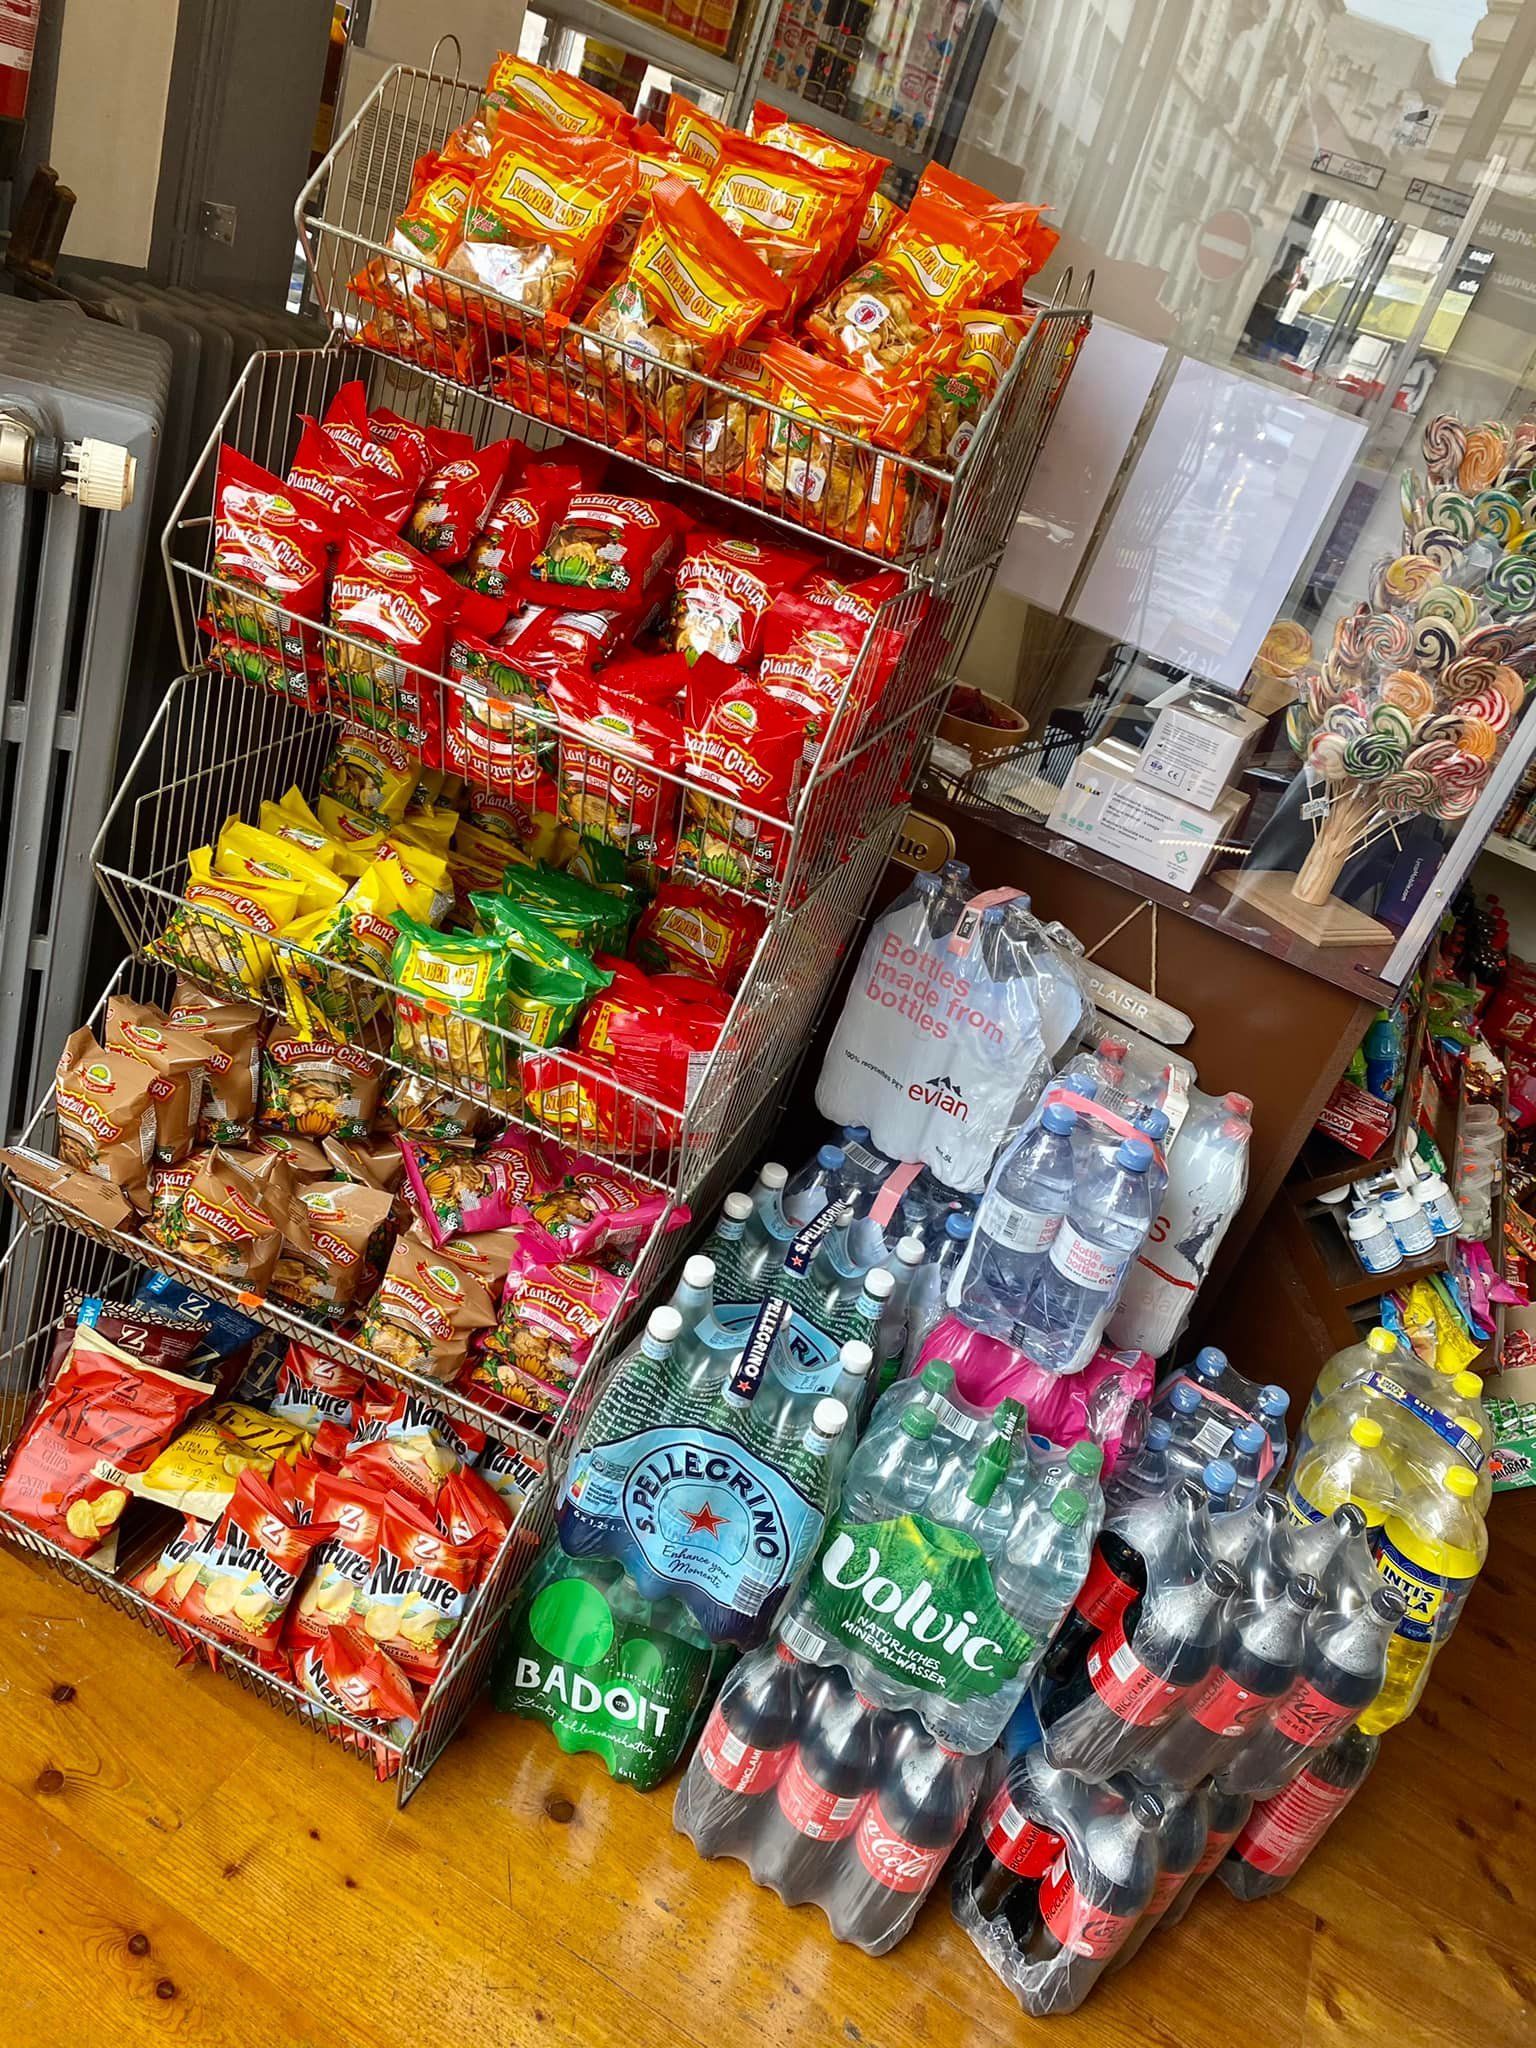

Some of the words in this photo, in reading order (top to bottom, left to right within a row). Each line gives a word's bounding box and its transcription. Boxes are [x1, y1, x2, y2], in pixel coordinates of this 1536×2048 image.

[508, 177, 556, 219] NUMBER
[730, 181, 770, 211] NUMBER
[655, 250, 695, 305] NUMBER
[691, 296, 717, 321] ONE
[501, 501, 532, 524] Chips
[616, 500, 654, 526] Chips
[274, 542, 308, 577] Chips
[611, 570, 631, 587] 85g
[731, 576, 769, 614] Chips
[389, 596, 424, 635] Chips
[760, 660, 817, 685] Plantain
[613, 765, 655, 799] Chips
[723, 751, 769, 788] Chips
[234, 897, 275, 935] Chips
[881, 931, 971, 998] Bottles
[866, 980, 949, 1041] bottles
[873, 959, 940, 1007] made
[947, 999, 1006, 1045] from
[1088, 979, 1149, 1020] PLAISIR
[512, 1013, 533, 1033] ONE
[275, 1043, 336, 1061] Plantain
[335, 1046, 373, 1073] Chips
[907, 1082, 969, 1122] evian
[82, 1107, 117, 1138] Chips
[511, 1169, 531, 1207] Chips
[186, 1194, 241, 1236] Plantain
[317, 1236, 353, 1264] Chips
[420, 1308, 450, 1338] Chips
[284, 1372, 349, 1415] Nature
[401, 1396, 468, 1457] Nature
[99, 1463, 127, 1484] SALT
[484, 1438, 540, 1491] Natur
[340, 1505, 365, 1530] Z
[631, 1449, 782, 1561] S.PELLEGRINO
[260, 1516, 286, 1545] Z
[414, 1535, 440, 1560] Z
[217, 1521, 297, 1597] Nature
[316, 1539, 370, 1583] ature
[662, 1545, 710, 1566] Enhance
[370, 1550, 459, 1609] Nature
[821, 1531, 1004, 1673] Volvic
[840, 1619, 948, 1689] MINERALWASSER
[857, 1615, 941, 1671] NATÜRLICHES
[344, 1679, 369, 1706] Z
[515, 1656, 671, 1738] BADOIT
[1114, 1672, 1156, 1716] RICICLAMI
[736, 1750, 762, 1792] RICICLAMI
[1011, 1827, 1041, 1871] RICICLAMI
[1046, 1880, 1076, 1922] RICICLAMI
